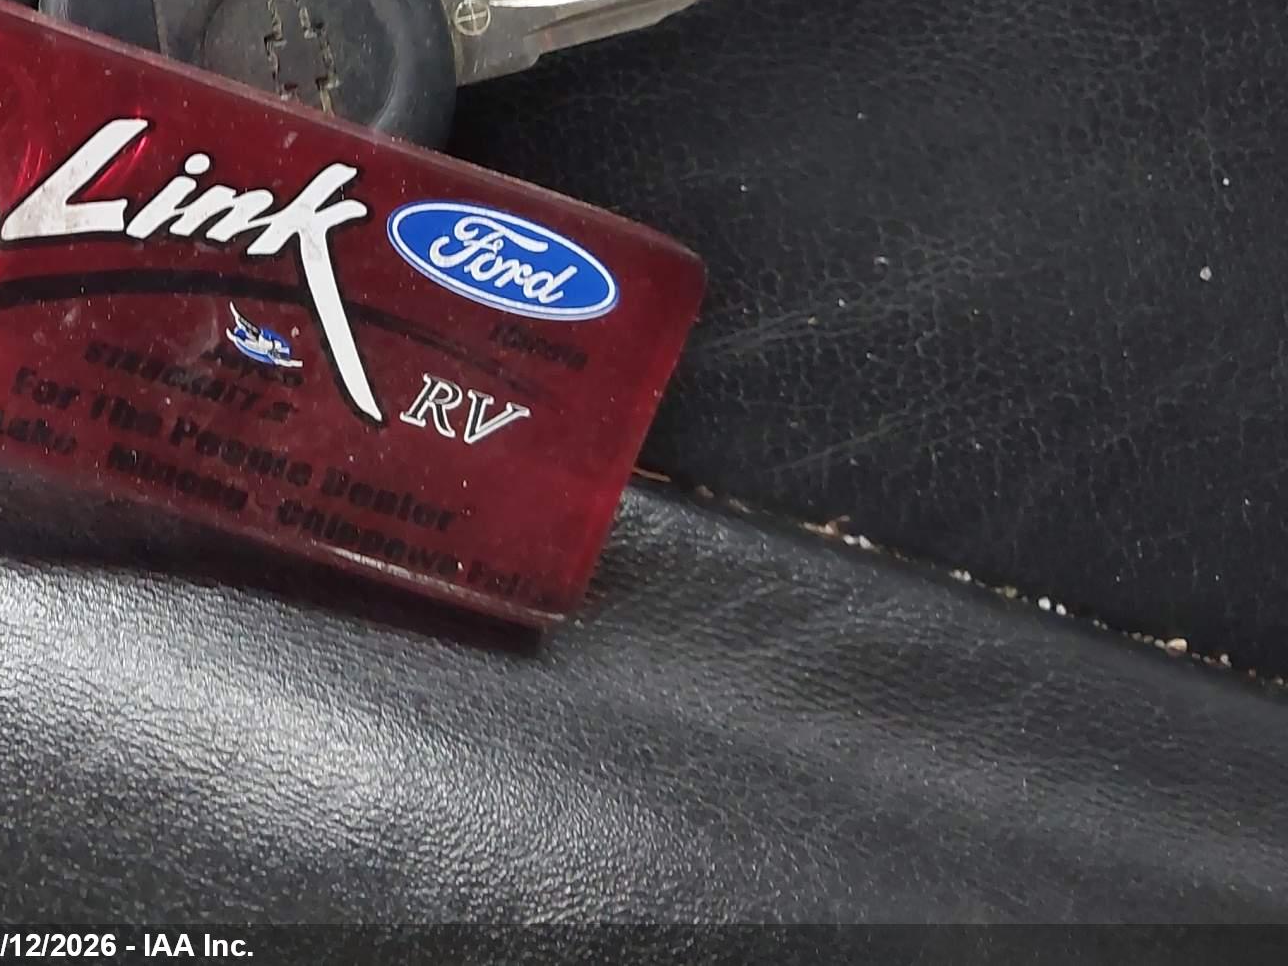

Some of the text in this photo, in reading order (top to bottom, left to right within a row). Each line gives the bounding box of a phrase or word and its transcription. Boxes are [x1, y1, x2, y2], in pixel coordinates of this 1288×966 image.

[1, 118, 384, 424] Link
[431, 216, 575, 306] Ford
[399, 372, 531, 446] RV
